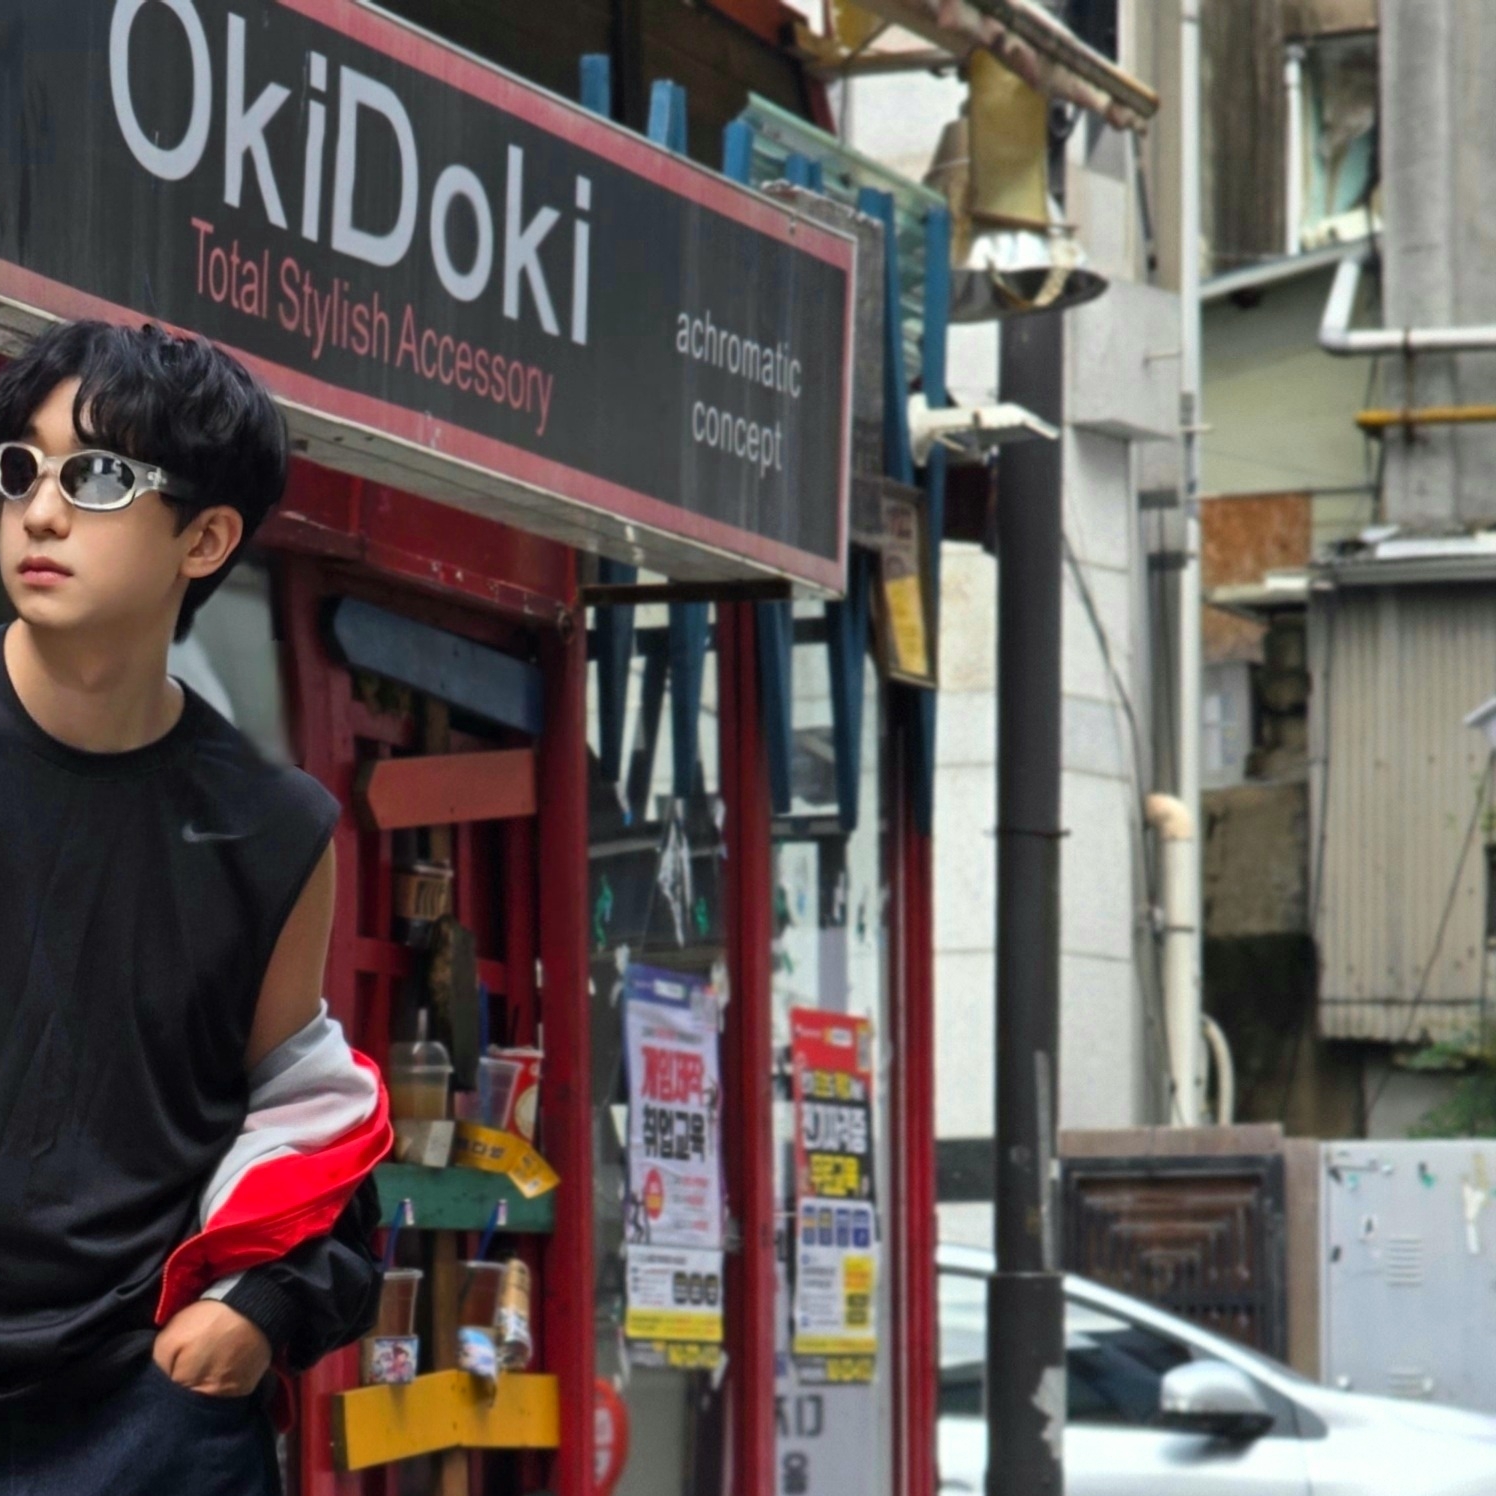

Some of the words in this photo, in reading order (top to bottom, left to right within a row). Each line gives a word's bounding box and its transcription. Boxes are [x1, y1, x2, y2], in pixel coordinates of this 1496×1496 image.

[109, 0, 592, 346] OkiDoki
[190, 216, 270, 319] Total
[277, 256, 391, 364] Stylish
[395, 303, 554, 437] Accessory
[676, 309, 802, 398] achromatic
[692, 400, 782, 480] concept
